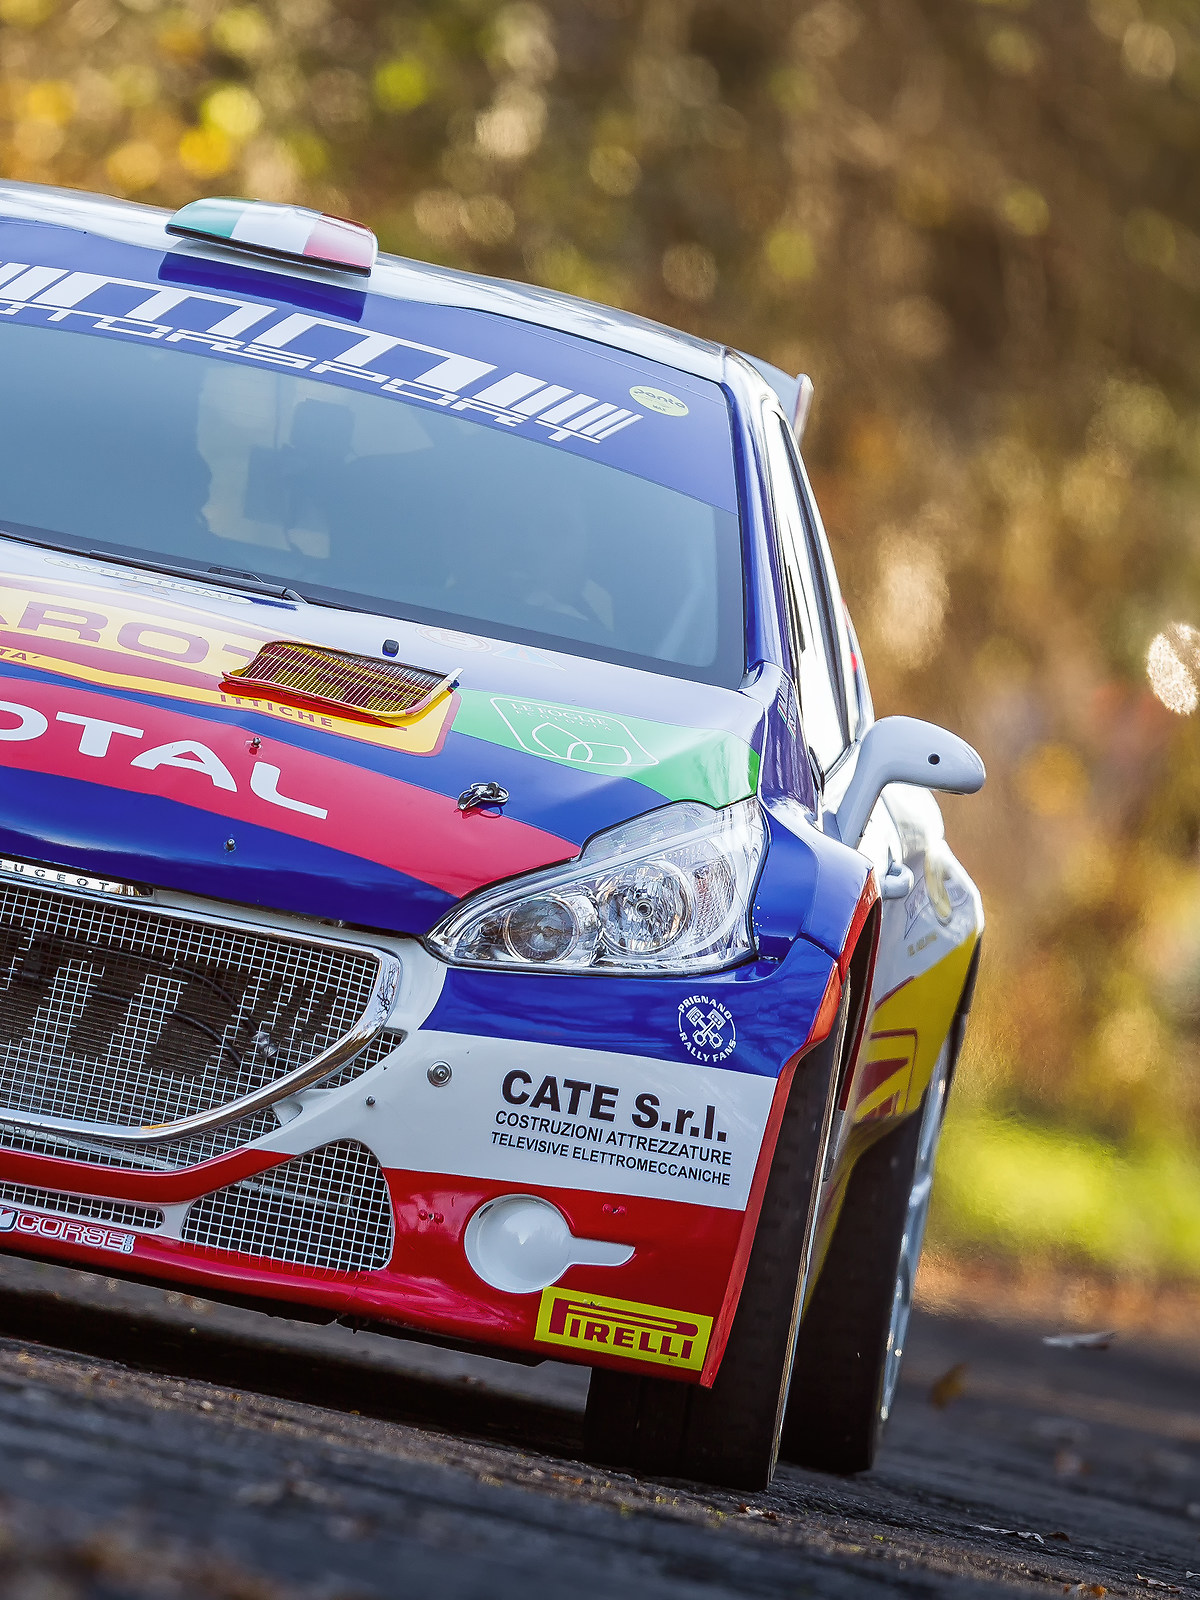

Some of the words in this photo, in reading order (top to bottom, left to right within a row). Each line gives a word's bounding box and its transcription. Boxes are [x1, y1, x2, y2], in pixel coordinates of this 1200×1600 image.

[220, 694, 334, 728] ITTICHE
[677, 995, 733, 1020] PRIGNANO
[679, 1032, 710, 1062] RALLY
[712, 1038, 737, 1063] FANS
[501, 1069, 620, 1123] CATE
[631, 1092, 729, 1143] S.r.l.
[491, 1131, 569, 1158] TELEVISIVE
[572, 1146, 731, 1186] ELETTROMECCANICHE
[495, 1110, 604, 1143] COSTRUZIONI
[605, 1130, 732, 1166] ATTREZZATURE
[15, 1213, 126, 1253] CORSE
[548, 1296, 699, 1361] PIRELLI
